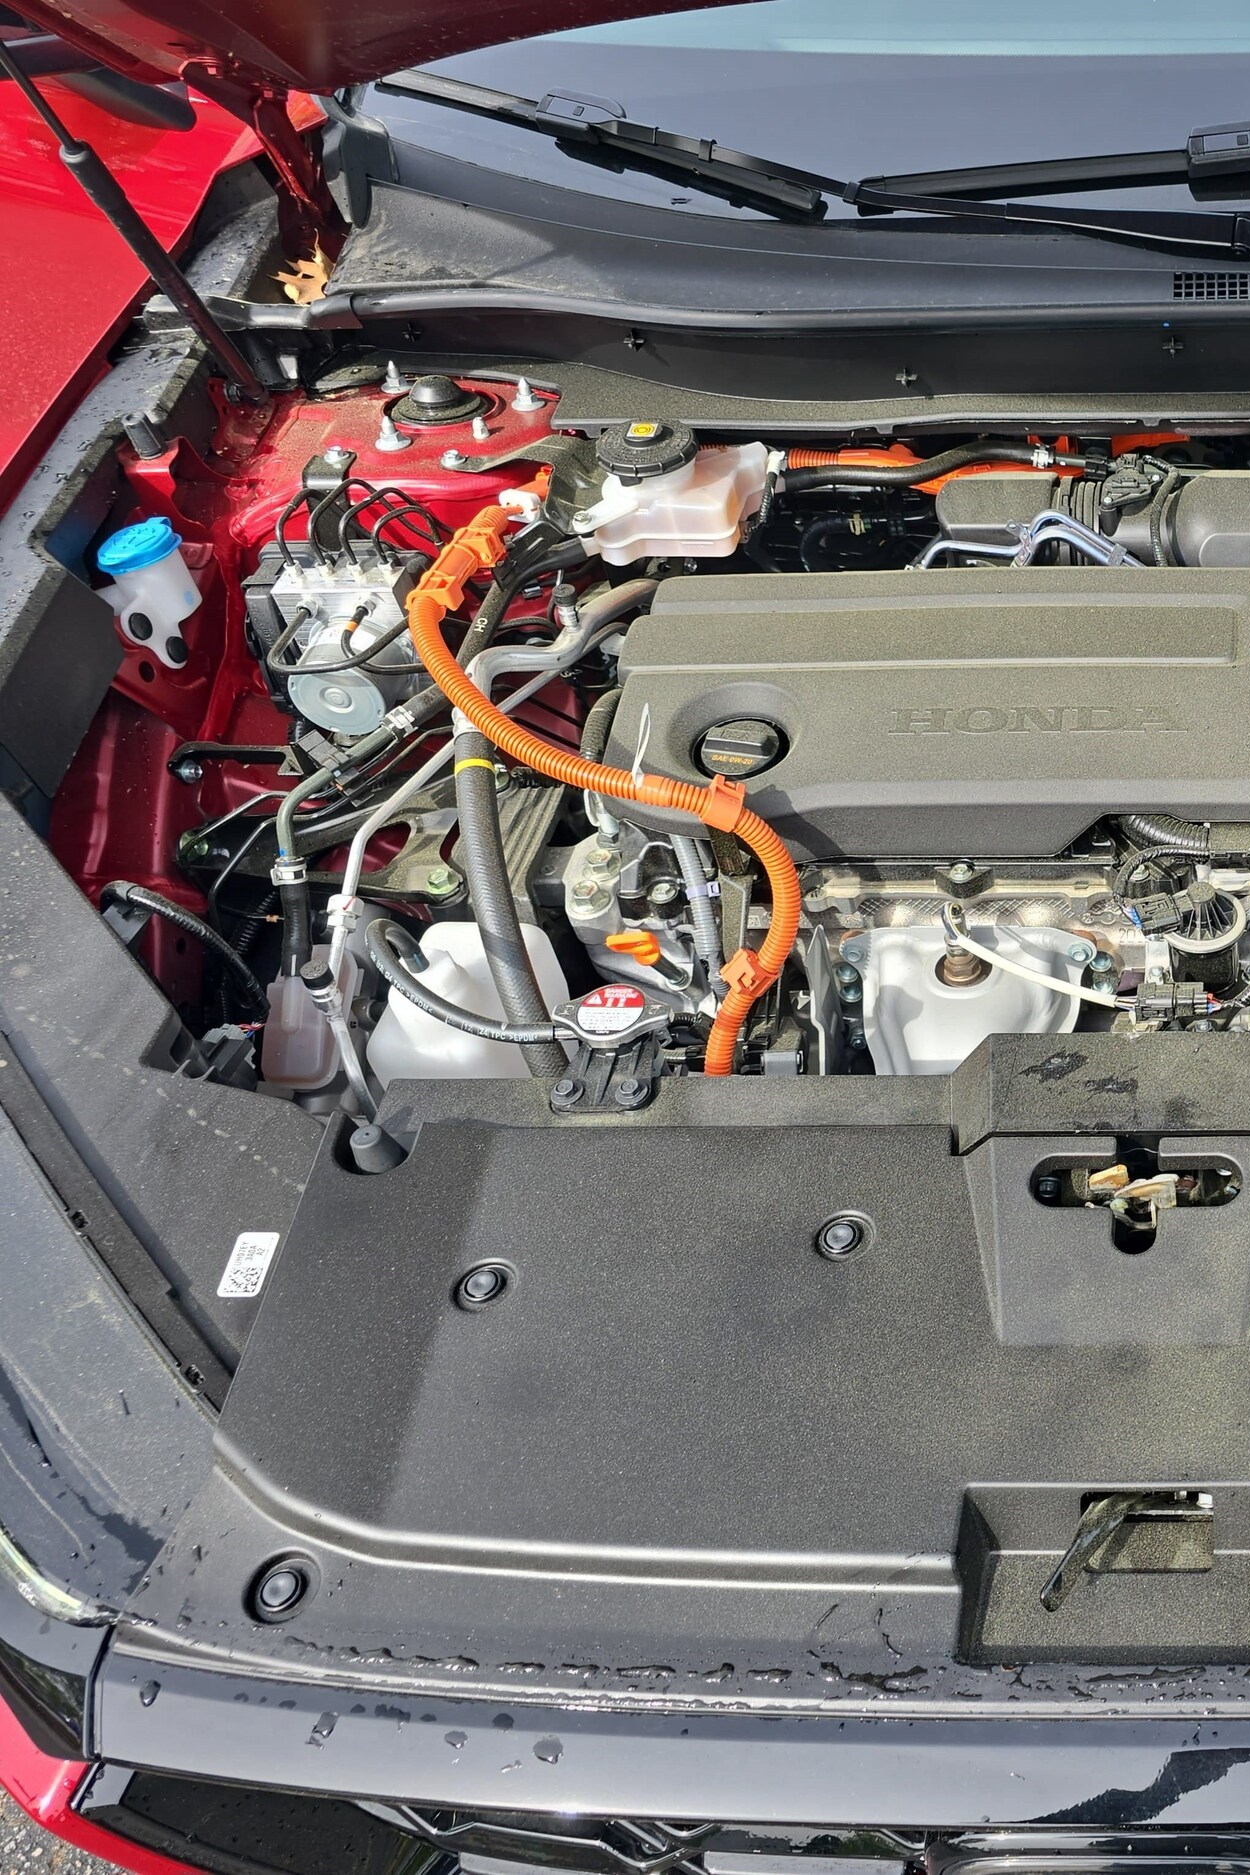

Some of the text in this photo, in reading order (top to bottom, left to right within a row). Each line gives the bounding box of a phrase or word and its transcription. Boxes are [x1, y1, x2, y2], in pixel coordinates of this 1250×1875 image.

[474, 617, 488, 632] CH
[888, 705, 1188, 735] HONDA
[711, 754, 753, 765] SAE 0W-20
[393, 979, 405, 994] TPC
[490, 1030, 506, 1041] TPC
